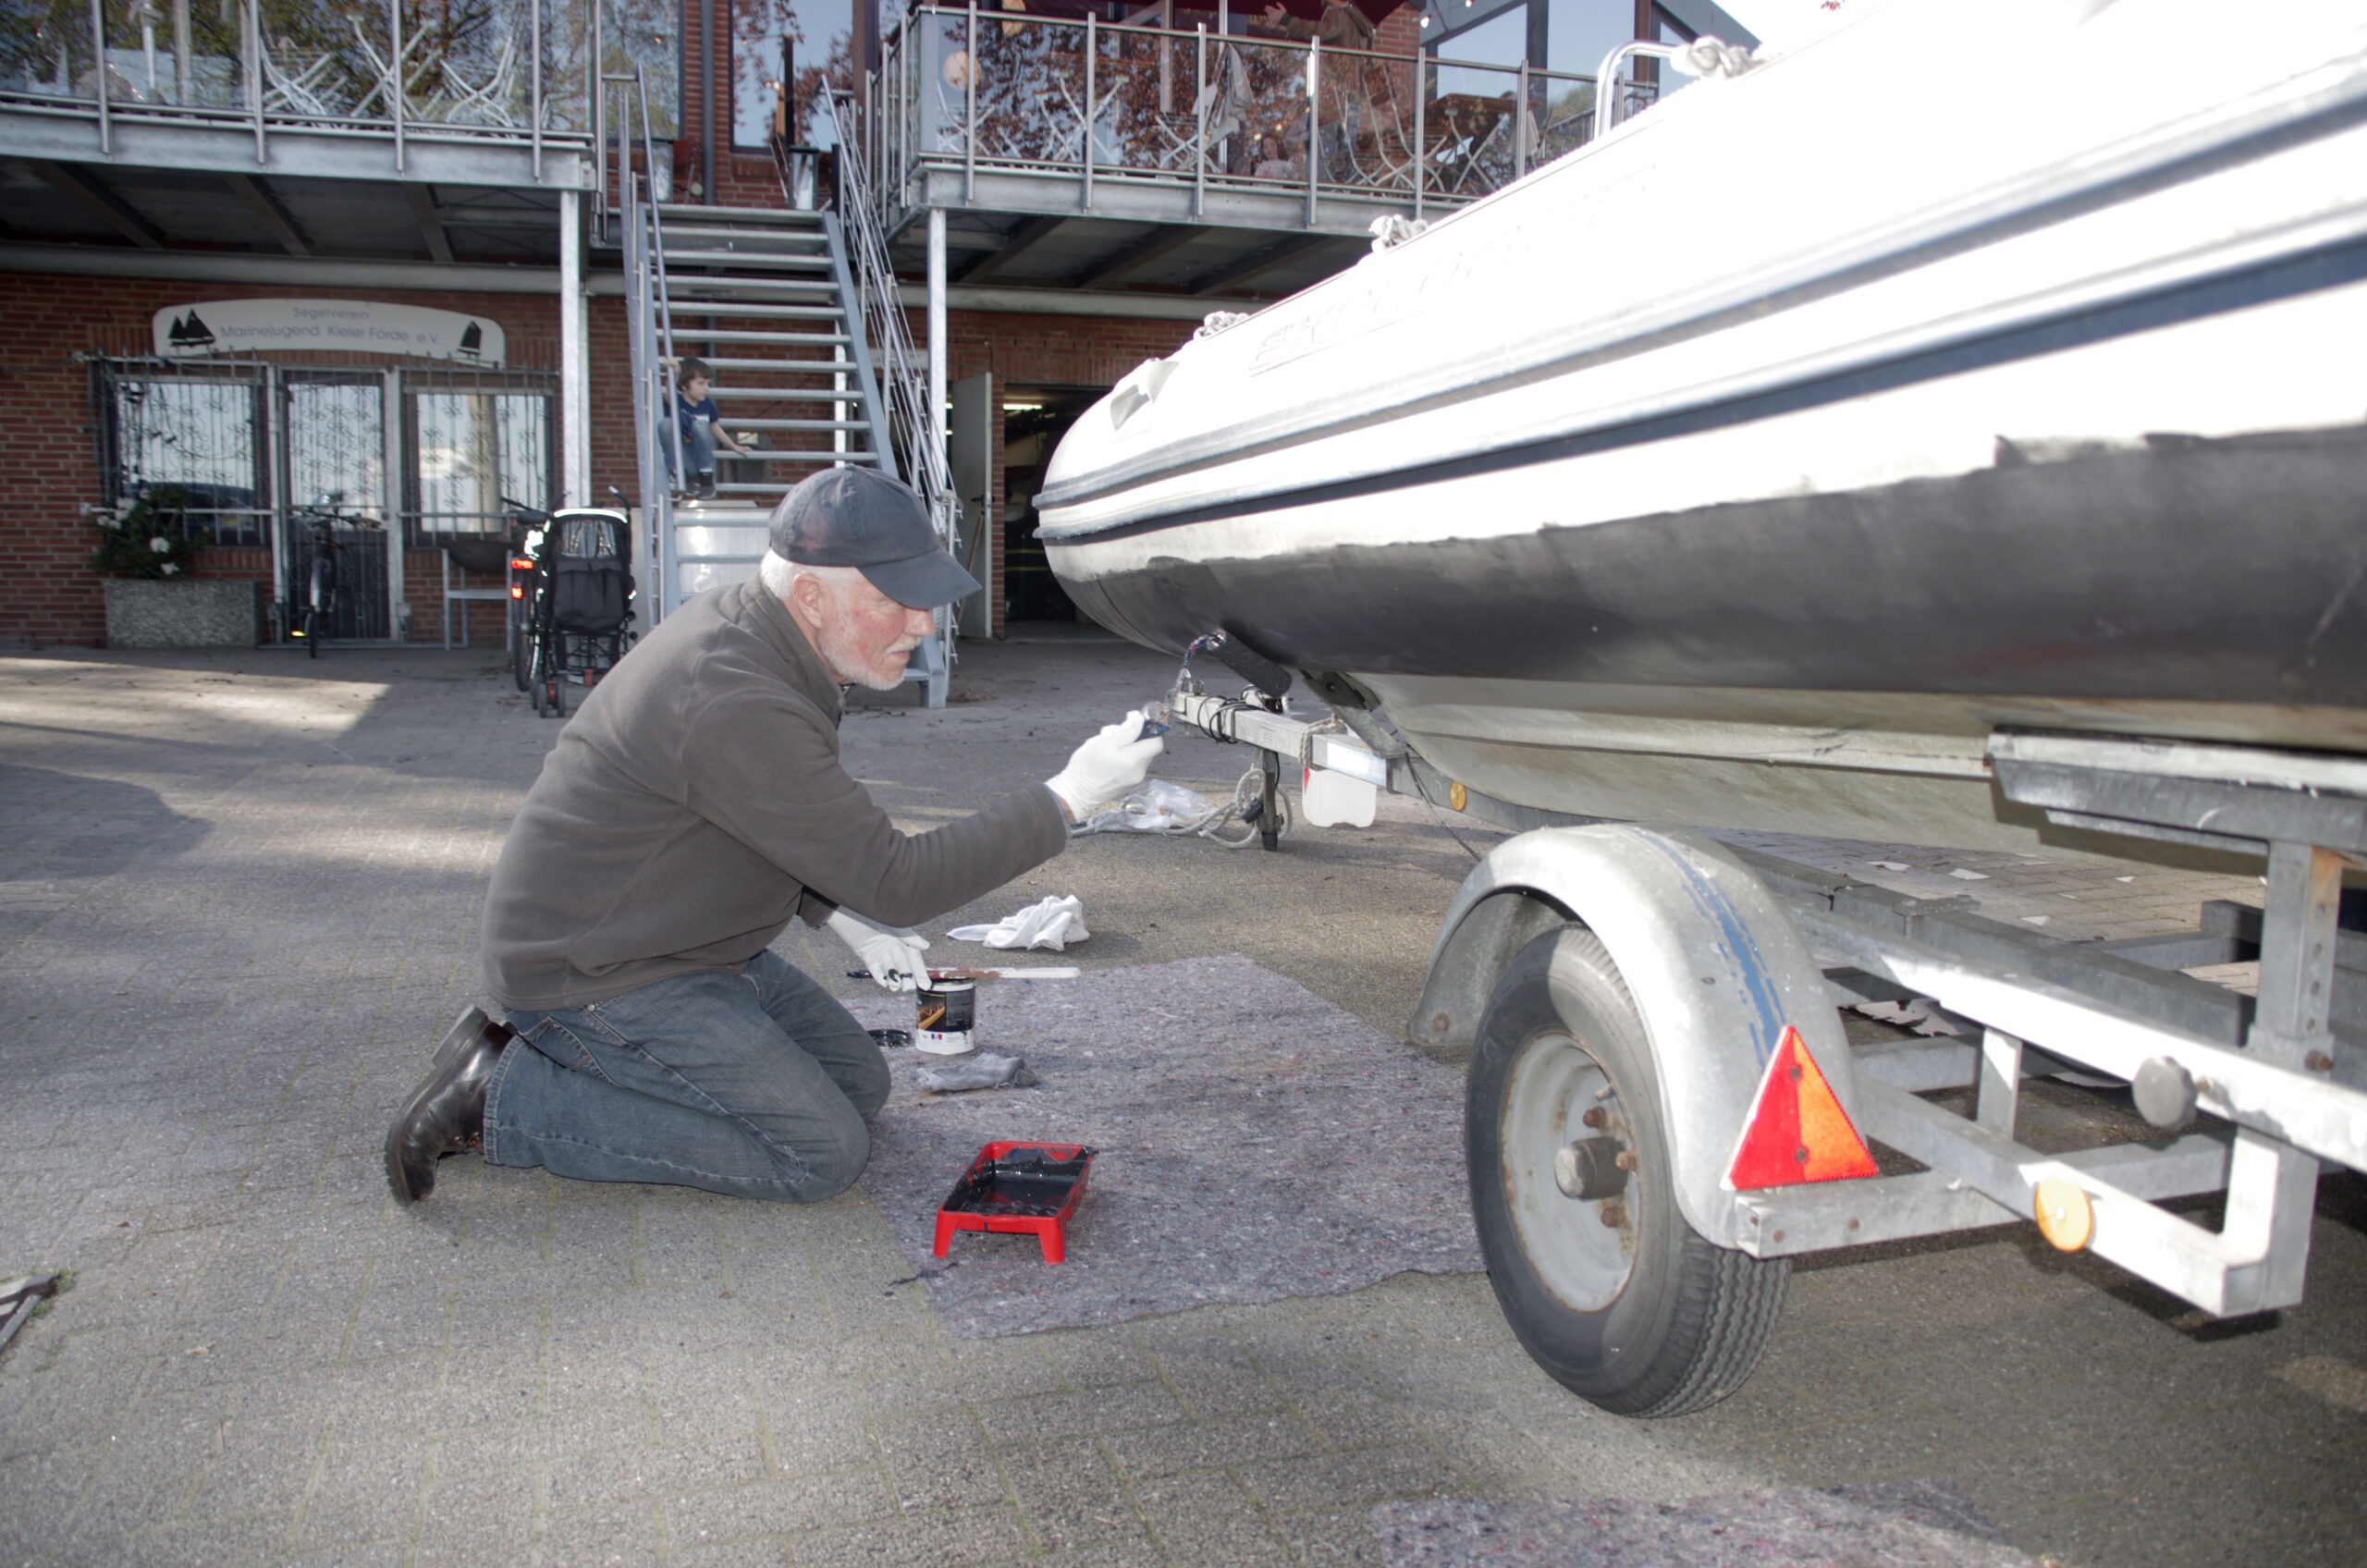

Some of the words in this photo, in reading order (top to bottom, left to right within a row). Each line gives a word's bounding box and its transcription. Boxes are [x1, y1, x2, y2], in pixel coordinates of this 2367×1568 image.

[292, 307, 371, 320] Segelverein
[220, 325, 320, 339] Marinejugend
[326, 325, 365, 338] Kieler
[368, 325, 409, 341] Förde
[416, 332, 441, 346] e.V.
